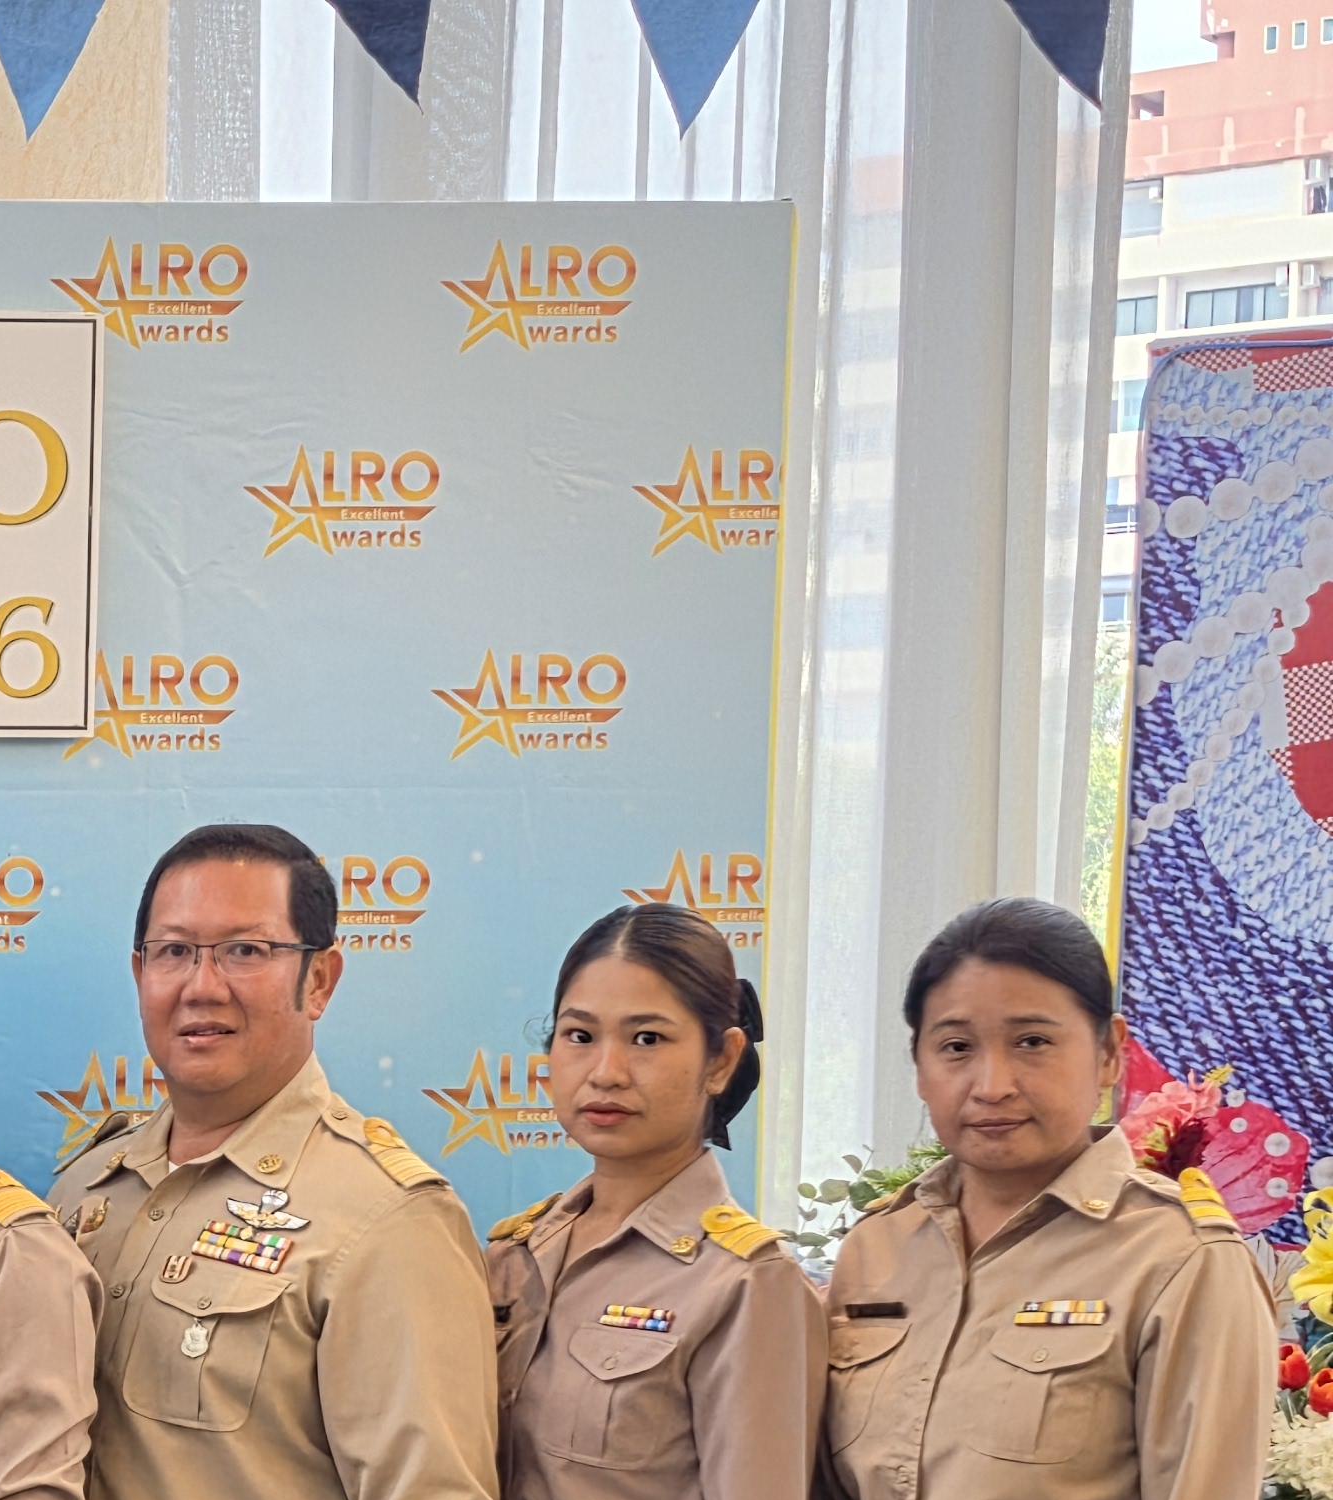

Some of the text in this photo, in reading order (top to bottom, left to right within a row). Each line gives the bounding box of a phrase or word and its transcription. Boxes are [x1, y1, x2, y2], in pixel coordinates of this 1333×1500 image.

[49, 235, 249, 306] ALRO
[440, 238, 637, 308] ALRO
[147, 302, 213, 315] Excellent
[536, 303, 601, 316] Excellent
[243, 443, 440, 513] ALRO
[631, 442, 783, 512] ALR
[341, 507, 406, 521] Excellent
[431, 647, 627, 716] ALRO
[140, 712, 204, 724] Excellent
[527, 711, 592, 723] Excellent
[341, 912, 396, 924] xcellent
[36, 1051, 169, 1116] ALR
[421, 1048, 554, 1116] ALR
